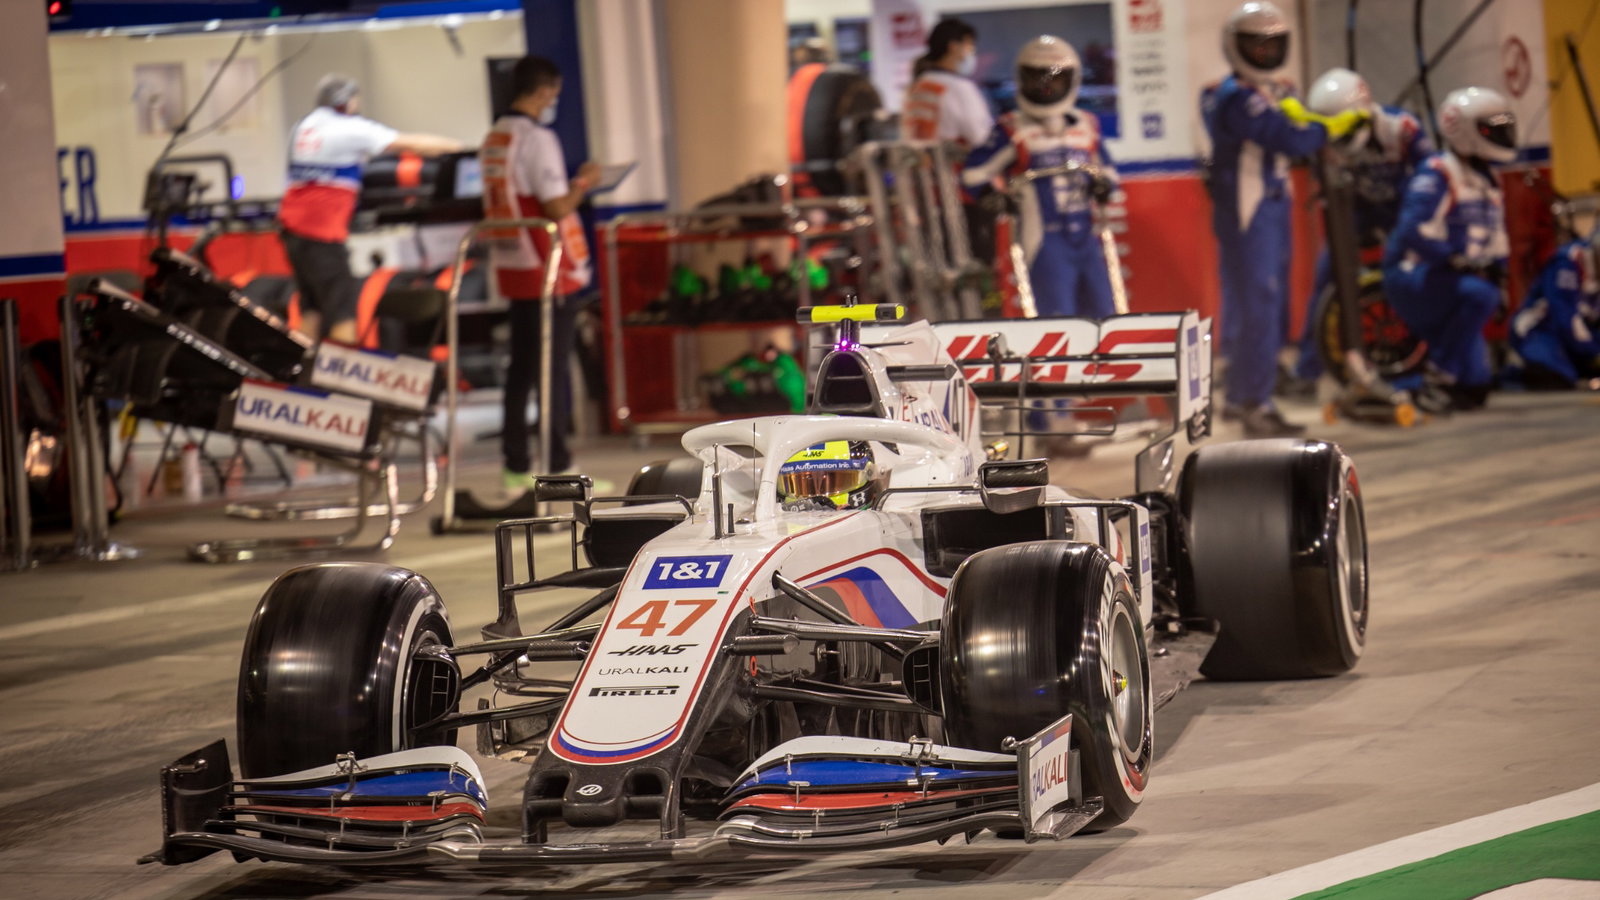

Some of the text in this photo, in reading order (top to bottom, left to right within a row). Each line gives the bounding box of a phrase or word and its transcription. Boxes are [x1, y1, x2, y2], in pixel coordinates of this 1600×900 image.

[315, 353, 430, 397] URALKALI
[238, 394, 368, 438] URALKALI
[795, 462, 838, 471] Automation
[838, 461, 851, 469] Inc.
[658, 561, 720, 581] 1&1
[616, 599, 718, 637] 47
[608, 643, 699, 656] HAAS
[599, 666, 689, 676] URALKALI
[589, 685, 680, 696] PIRELLI
[1030, 752, 1068, 806] RALKALI
